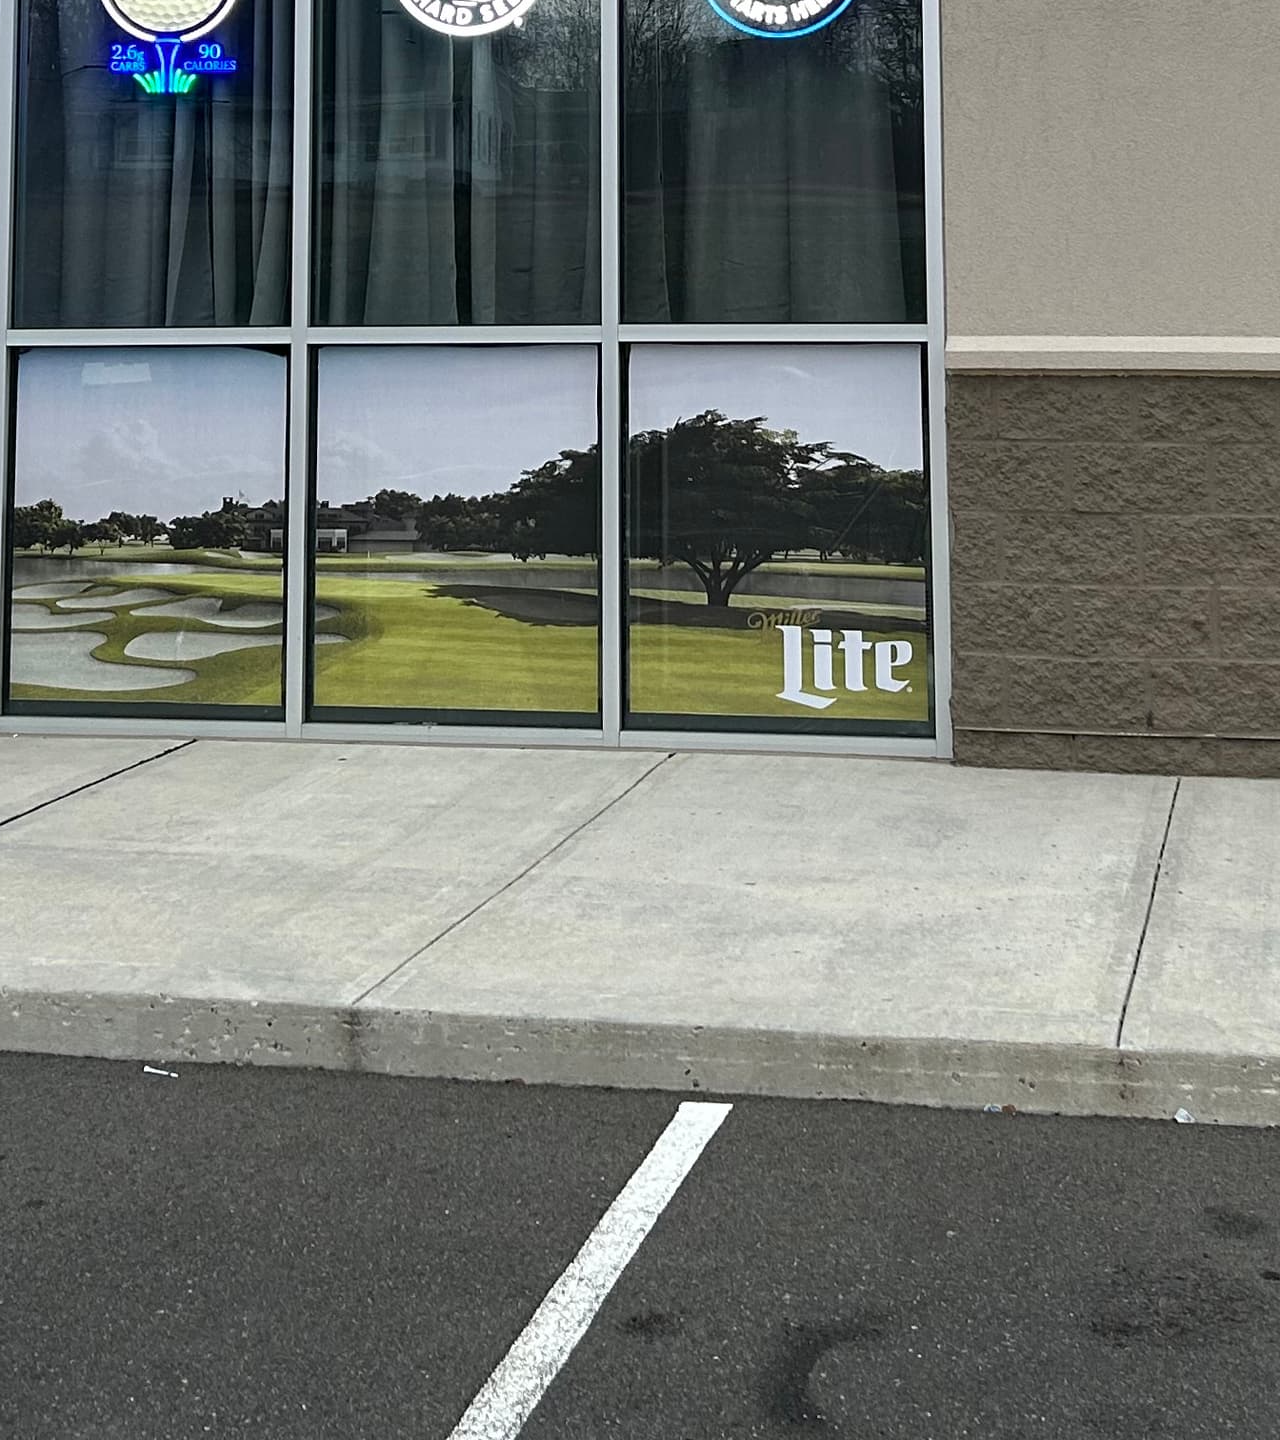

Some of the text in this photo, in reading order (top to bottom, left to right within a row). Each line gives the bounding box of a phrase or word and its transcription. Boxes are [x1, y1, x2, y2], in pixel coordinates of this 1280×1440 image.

[198, 43, 222, 59] 90
[110, 61, 145, 72] CARBS
[183, 60, 237, 71] CALORIES
[747, 609, 822, 638] Miller
[775, 624, 913, 710] Lite
